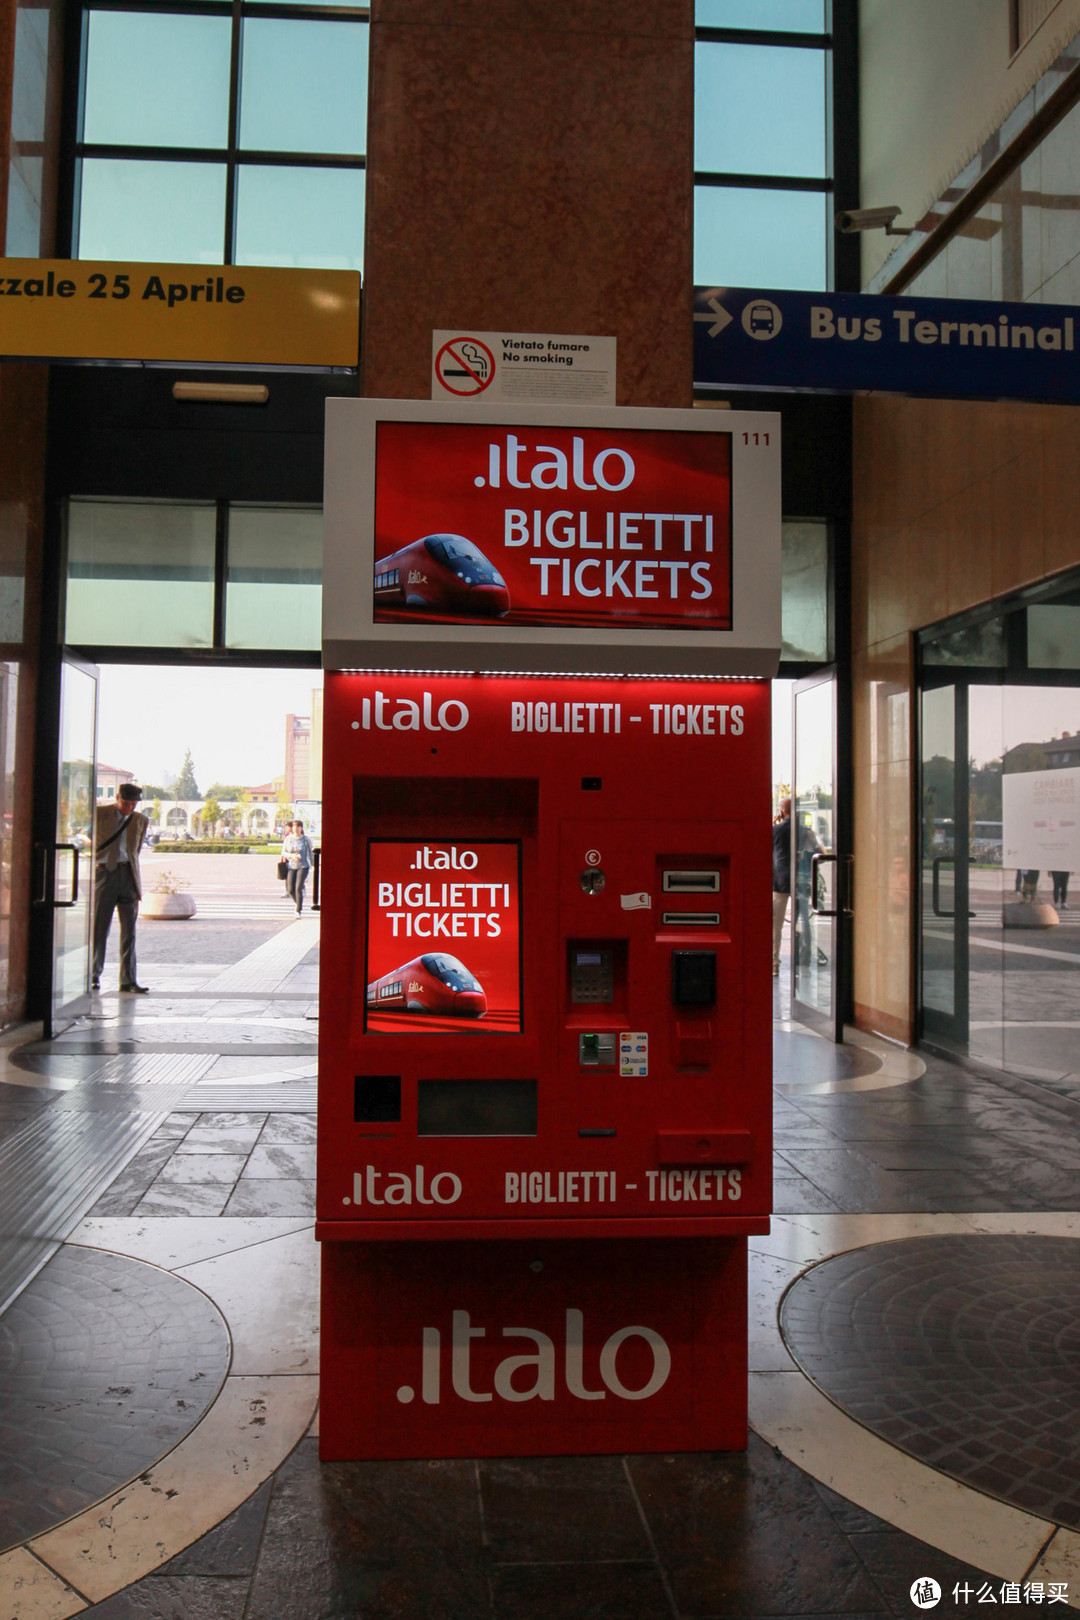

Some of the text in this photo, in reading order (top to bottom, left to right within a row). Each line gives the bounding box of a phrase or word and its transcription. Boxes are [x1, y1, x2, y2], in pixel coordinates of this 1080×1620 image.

[88, 273, 131, 300] 25
[142, 276, 246, 307] Aprile
[501, 339, 590, 352] Vietato fumare
[810, 306, 1074, 351] Bus Terminal
[503, 352, 573, 366] No smoking
[742, 432, 770, 446] 111
[504, 508, 713, 552] BIGLIETTI
[530, 557, 713, 600] TICKETS
[511, 701, 621, 734] BIGLIETTI
[649, 703, 744, 736] TICKETS
[378, 882, 510, 908] BIGLIETTI
[386, 912, 501, 937] TICKETS
[505, 1171, 616, 1203] BIGLIETTI
[645, 1169, 741, 1202] TICKETS
